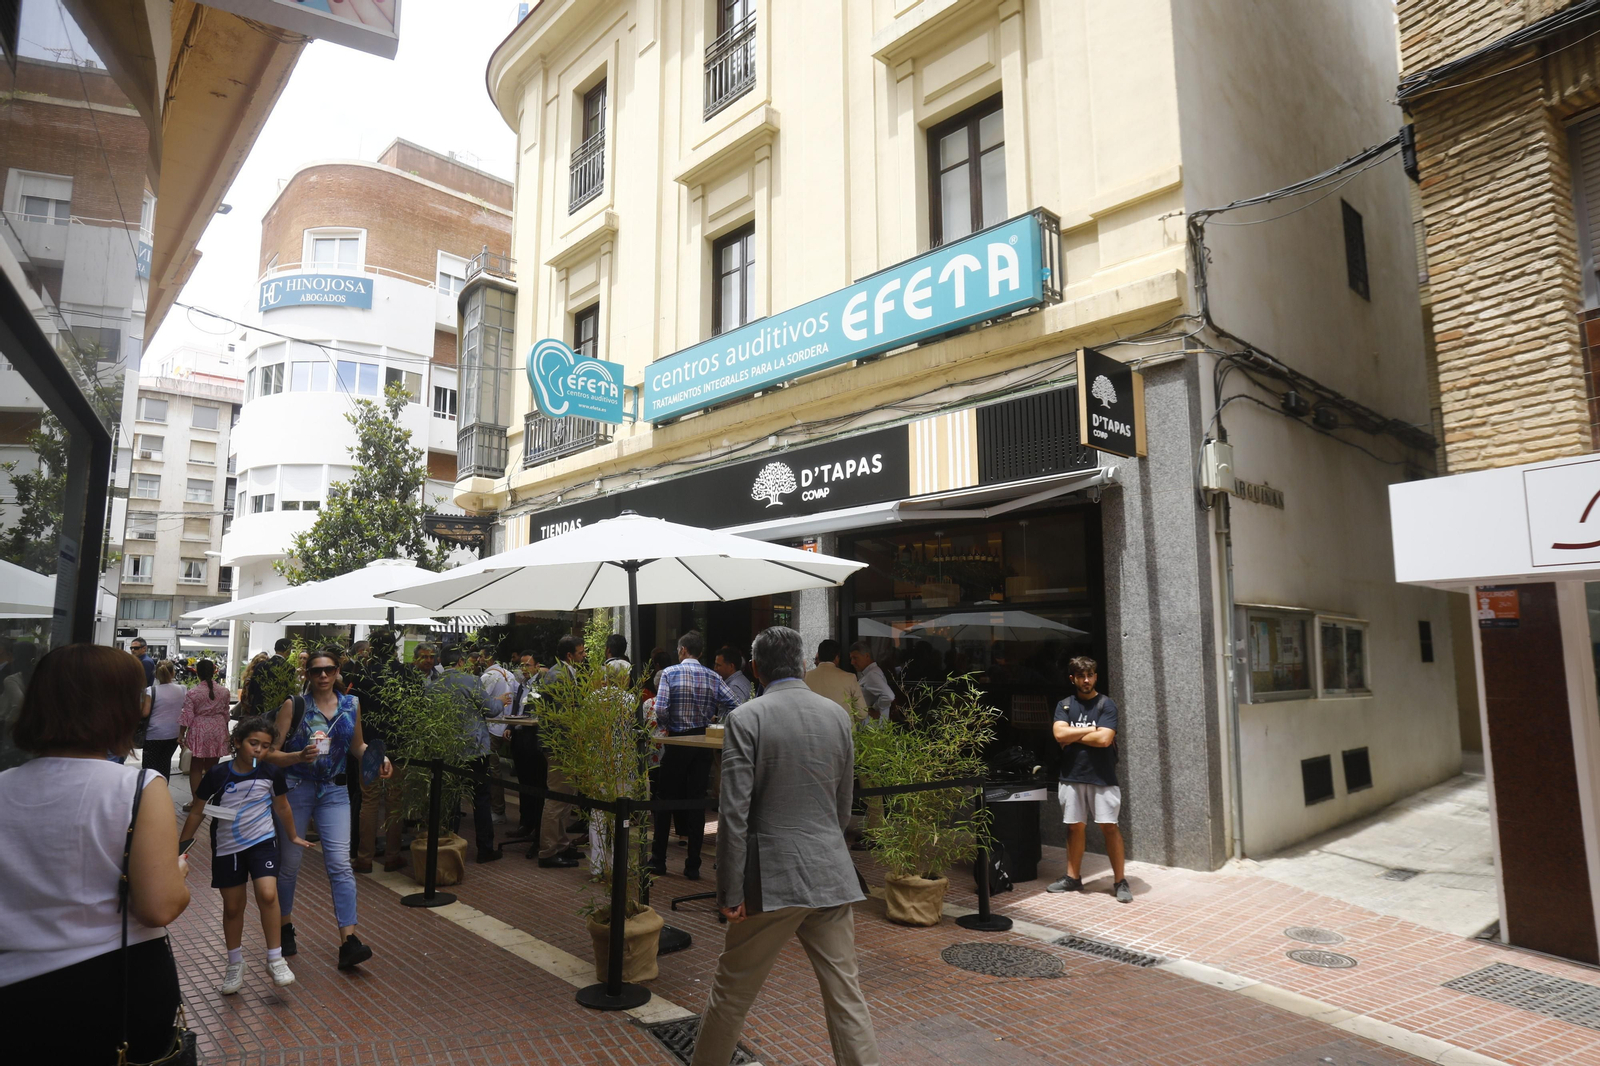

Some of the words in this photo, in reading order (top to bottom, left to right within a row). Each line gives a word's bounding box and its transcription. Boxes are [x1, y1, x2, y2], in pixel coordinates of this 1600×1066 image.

[286, 278, 366, 294] HINOJOSA
[300, 293, 346, 303] ABOGADOS
[652, 353, 719, 392] centros
[725, 311, 829, 366] auditivos
[566, 374, 619, 398] EFETA
[652, 385, 701, 410] TRATAMIENTOS
[703, 369, 749, 393] INTEGRALES
[751, 363, 772, 378] PARA
[774, 357, 785, 369] LA
[787, 342, 829, 366] SORDERA
[566, 389, 590, 399] centros
[590, 394, 618, 405] auditivos
[1092, 413, 1131, 438] D'TAPAS
[801, 453, 883, 488] D'TAPAS
[801, 487, 830, 501] COVAP
[540, 518, 582, 539] TIENDAS
